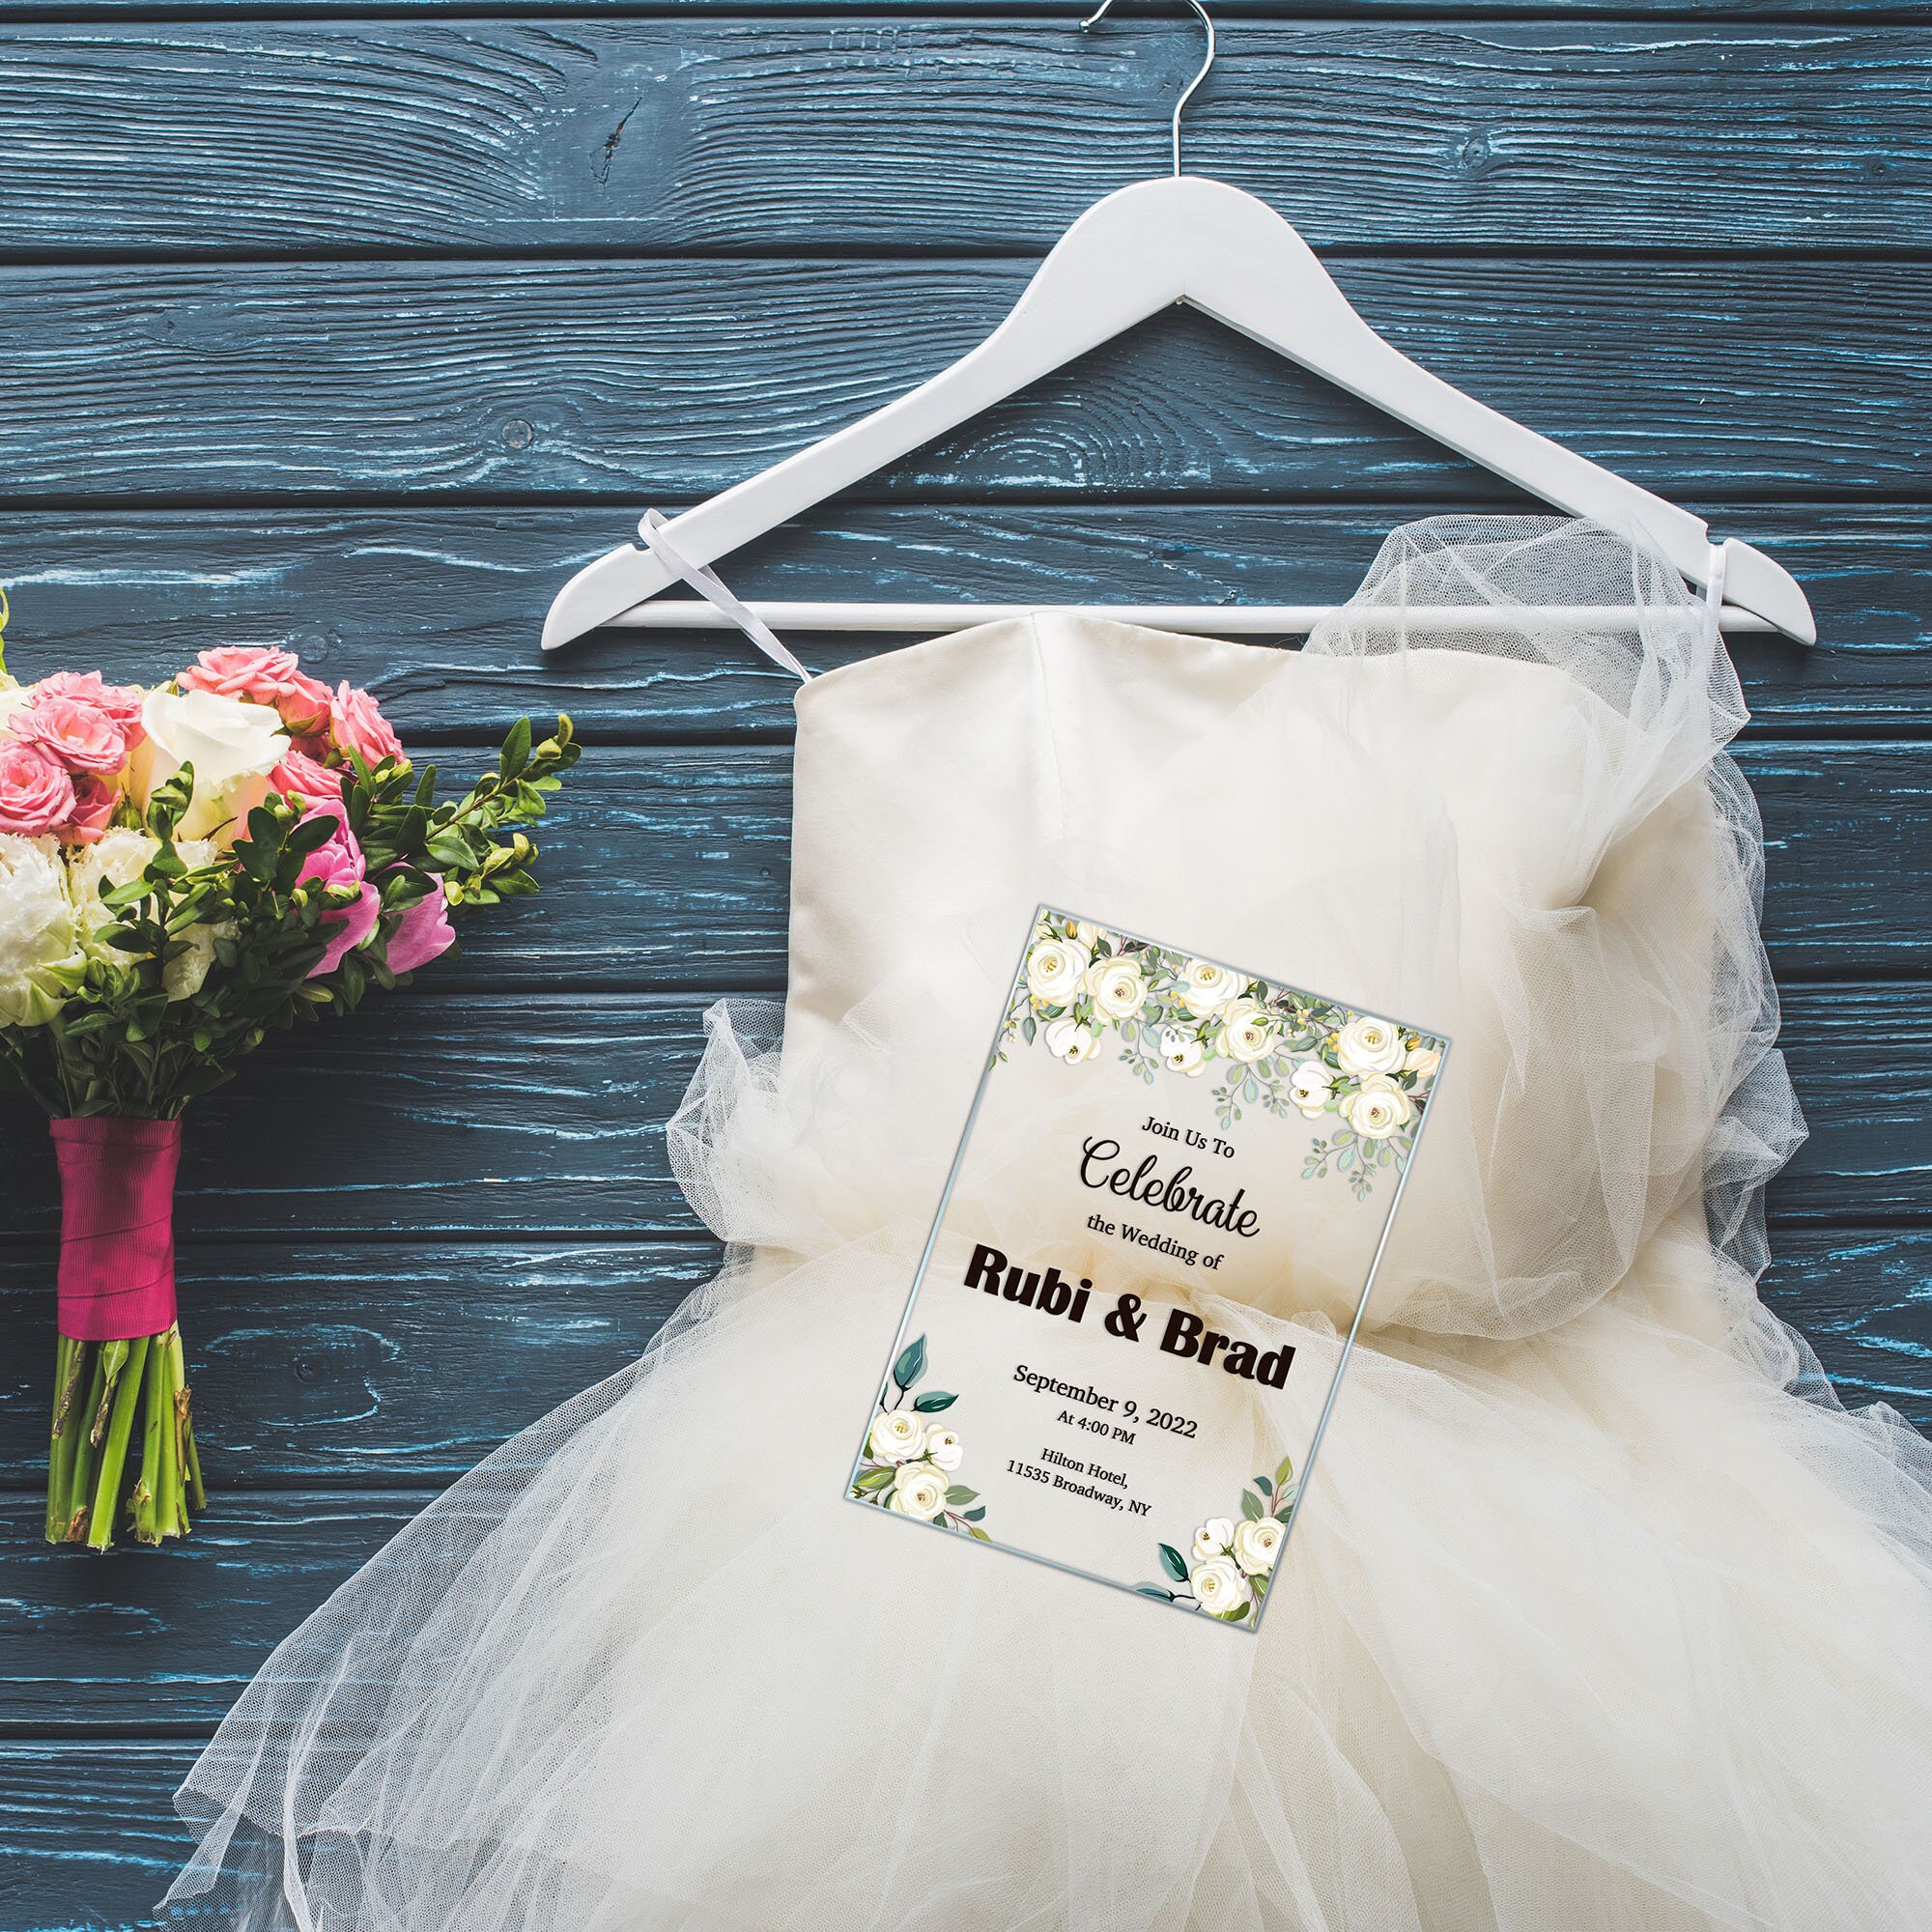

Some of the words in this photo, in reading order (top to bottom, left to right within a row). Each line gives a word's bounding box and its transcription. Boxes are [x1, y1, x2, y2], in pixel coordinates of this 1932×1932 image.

[1141, 1116, 1180, 1142] Join
[1184, 1128, 1208, 1151] Us
[1212, 1137, 1236, 1159] To
[1079, 1135, 1261, 1238] Celebrate
[1086, 1213, 1117, 1236] the
[1121, 1223, 1200, 1266] Wedding
[1202, 1253, 1226, 1271] of
[962, 1242, 1094, 1324] Rubi
[1103, 1293, 1148, 1344] &
[1158, 1307, 1297, 1391] Brad
[1012, 1364, 1120, 1413] September
[1122, 1400, 1140, 1424] 9,
[1145, 1407, 1199, 1439] 2022
[1056, 1409, 1076, 1426] At
[1076, 1416, 1110, 1436] 4:00
[1110, 1426, 1137, 1446] PM
[1006, 1459, 1052, 1485] 11535
[1051, 1474, 1124, 1512] Broadway,
[1127, 1498, 1152, 1518] NY
[1039, 1447, 1085, 1474] Hilton
[1086, 1463, 1128, 1491] Hotel,
